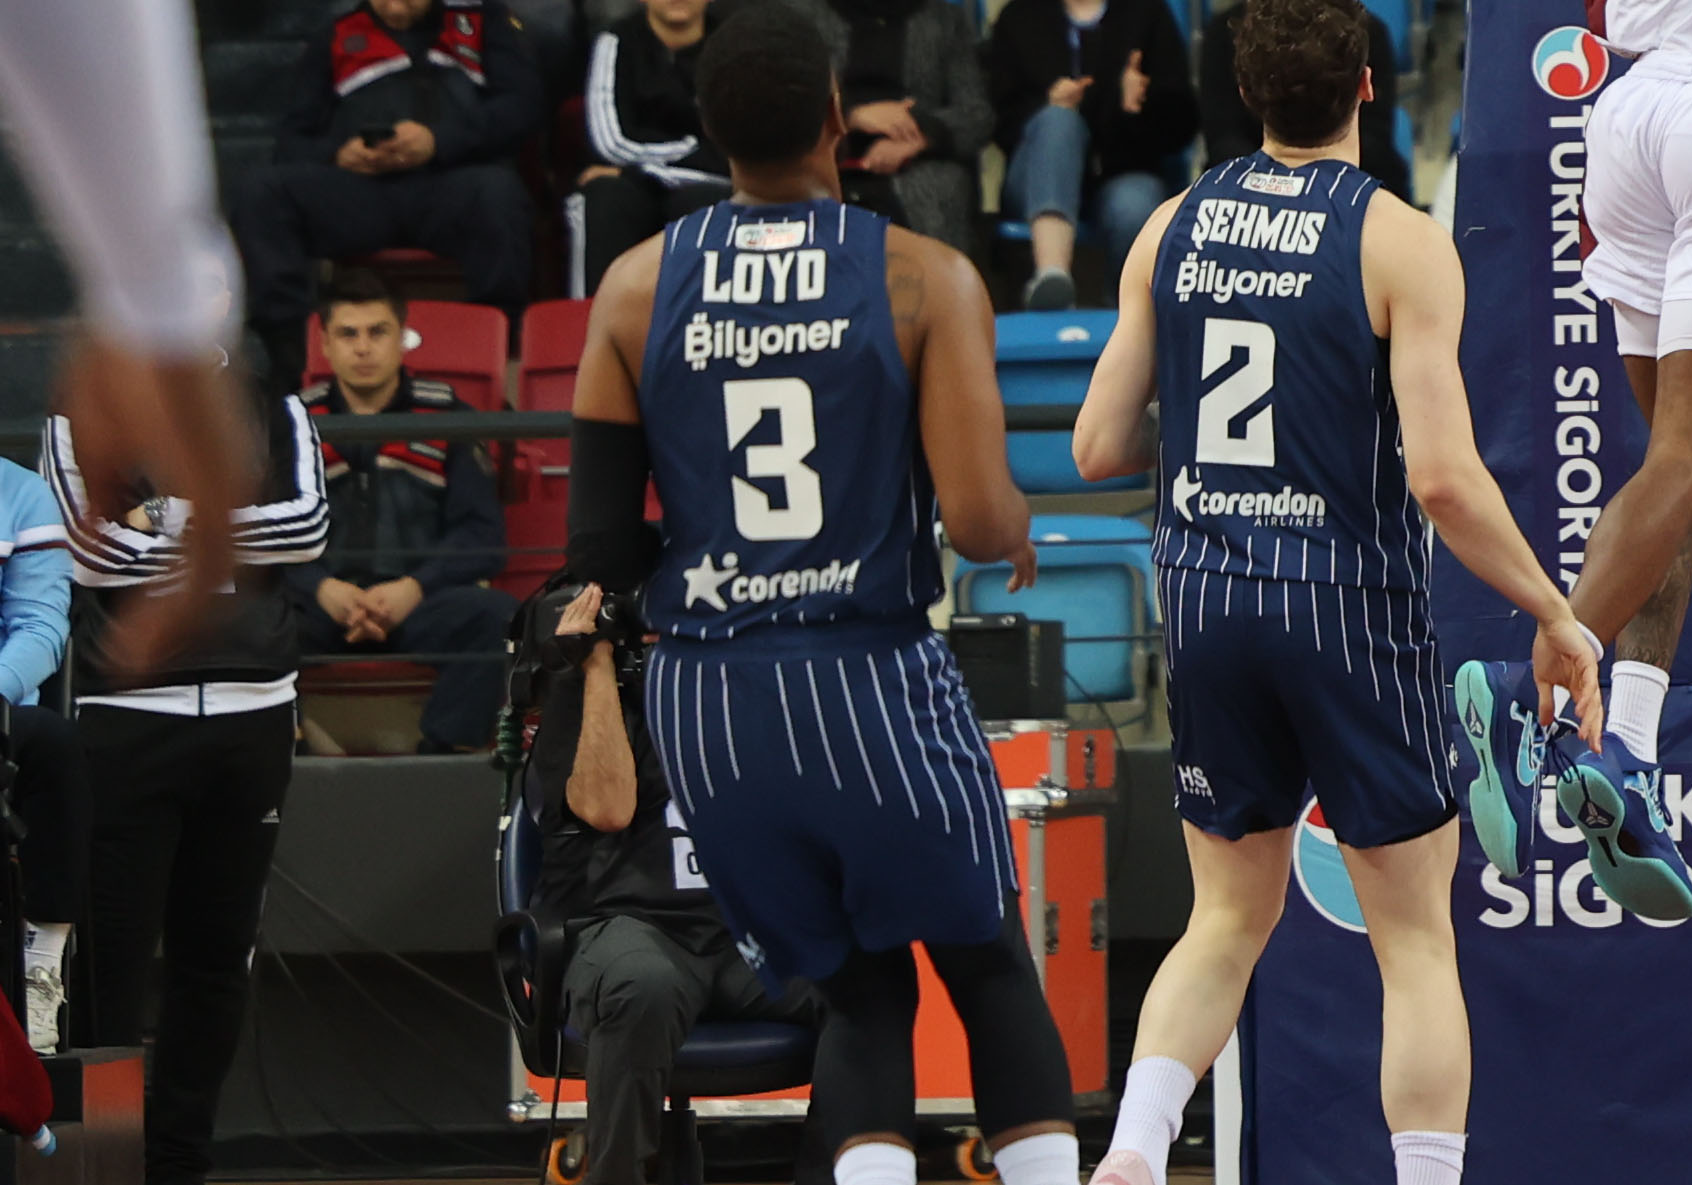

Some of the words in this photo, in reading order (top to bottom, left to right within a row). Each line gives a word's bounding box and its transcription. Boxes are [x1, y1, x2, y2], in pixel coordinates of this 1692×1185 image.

[702, 248, 826, 304] LOYD
[1174, 252, 1313, 305] Bilyoner
[684, 312, 850, 372] Bilyoner
[1195, 317, 1277, 468] 2
[723, 377, 824, 542] 3
[1198, 485, 1326, 517] corendon
[1254, 517, 1325, 528] AIRLINES
